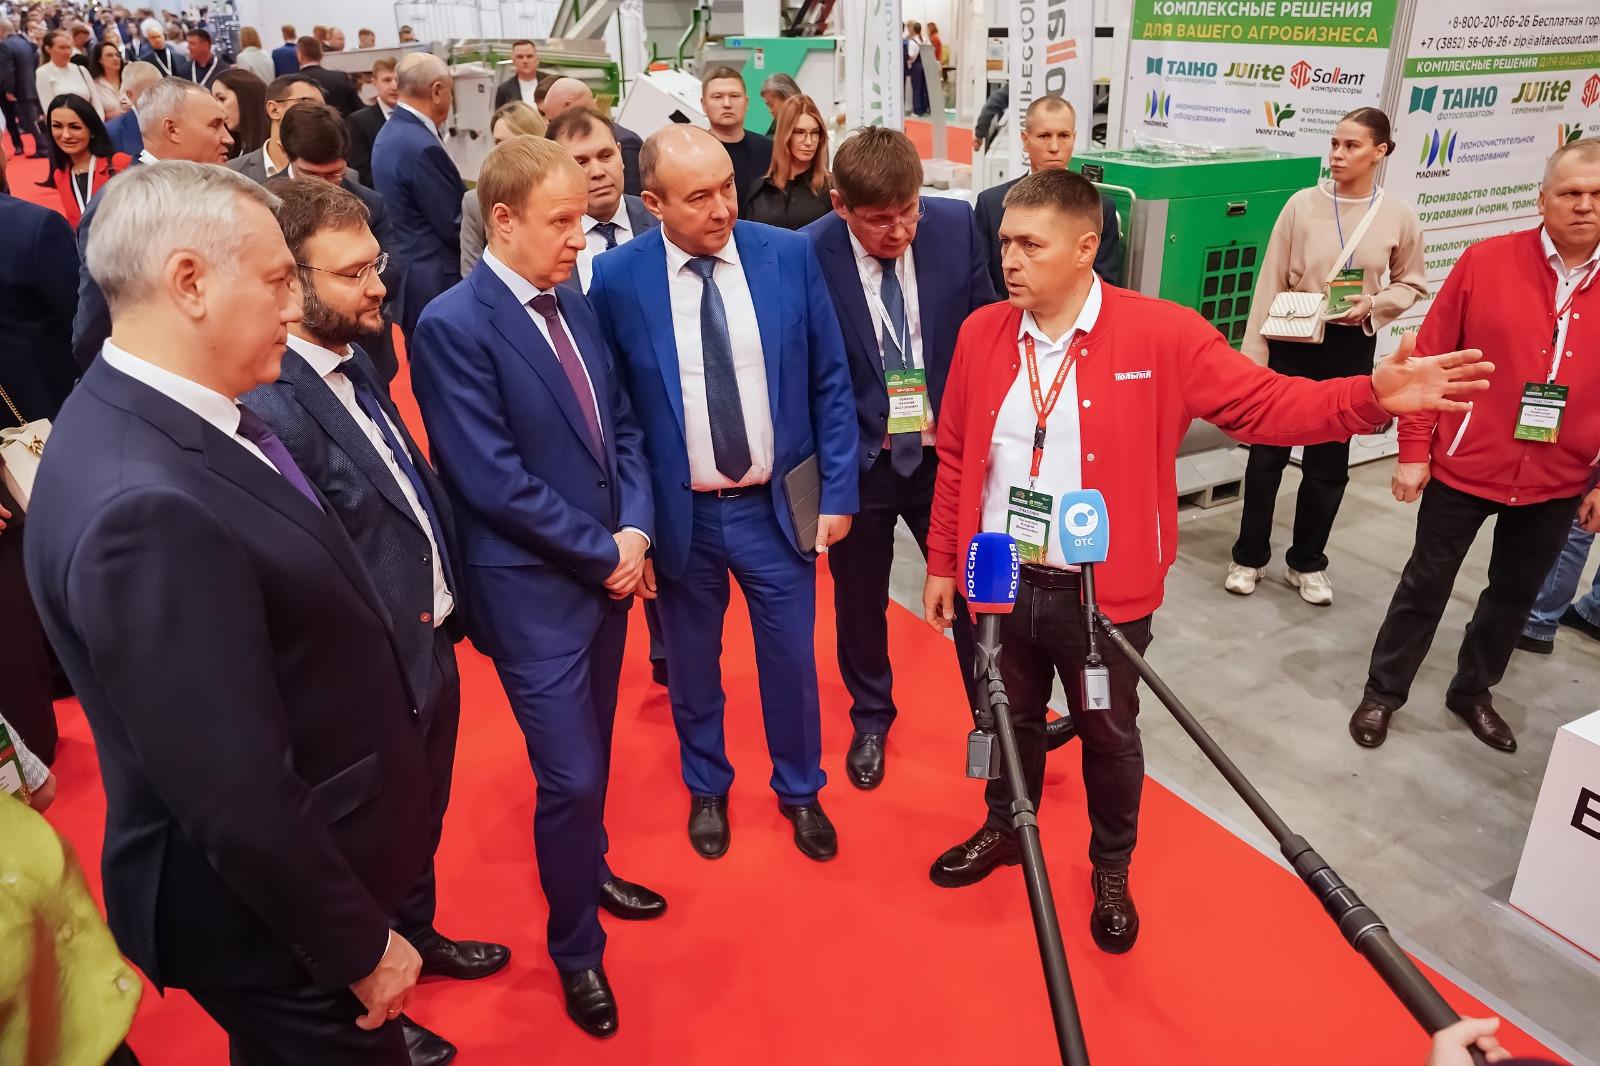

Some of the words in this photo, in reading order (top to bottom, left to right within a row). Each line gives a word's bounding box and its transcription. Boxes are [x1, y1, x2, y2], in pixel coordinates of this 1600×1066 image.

[1153, 1, 1275, 18] КОМПЛЕКСНЫЕ
[1280, 1, 1373, 18] РЕШЕНИЯ
[1453, 15, 1530, 29] 8-800-201-66-26
[1532, 15, 1583, 27] Бесплатная
[1585, 16, 1600, 28] гор
[1143, 23, 1173, 37] ДЛЯ
[1176, 24, 1243, 39] ВАШЕГО
[1248, 25, 1379, 43] АГРОБИЗНЕСА
[1421, 37, 1433, 50] +7
[1436, 37, 1465, 51] (3852)
[1467, 36, 1508, 48] 56-06-26
[1167, 60, 1218, 78] TAIHO
[1416, 58, 1490, 73] КОМПЛЕКСНЫЕ
[1493, 57, 1538, 70] РЕШЕНИЯ
[1539, 56, 1558, 68] ДЛЯ
[1559, 54, 1595, 66] ВАШЕГО
[1312, 66, 1366, 86] Sollant
[1311, 86, 1363, 95] компрессоры
[1442, 85, 1499, 110] TAIHO
[1175, 102, 1252, 116] зерноочистительное
[1437, 110, 1495, 121] фотосепараторы
[1511, 105, 1545, 115] семенные
[1173, 112, 1226, 124] оборудование
[1255, 128, 1297, 138] WINTONE
[1299, 127, 1337, 136] комплекс
[1589, 124, 1600, 133] кру
[1459, 135, 1535, 150] зерноочистительное
[1456, 152, 1510, 164] оборудование
[1417, 188, 1488, 206] Производство
[1418, 207, 1473, 222] рудования
[1475, 201, 1509, 216] (нории,
[1424, 257, 1458, 270] позаво
[967, 542, 979, 598] РОССИЯ
[1008, 543, 1018, 599] РОССИЯ
